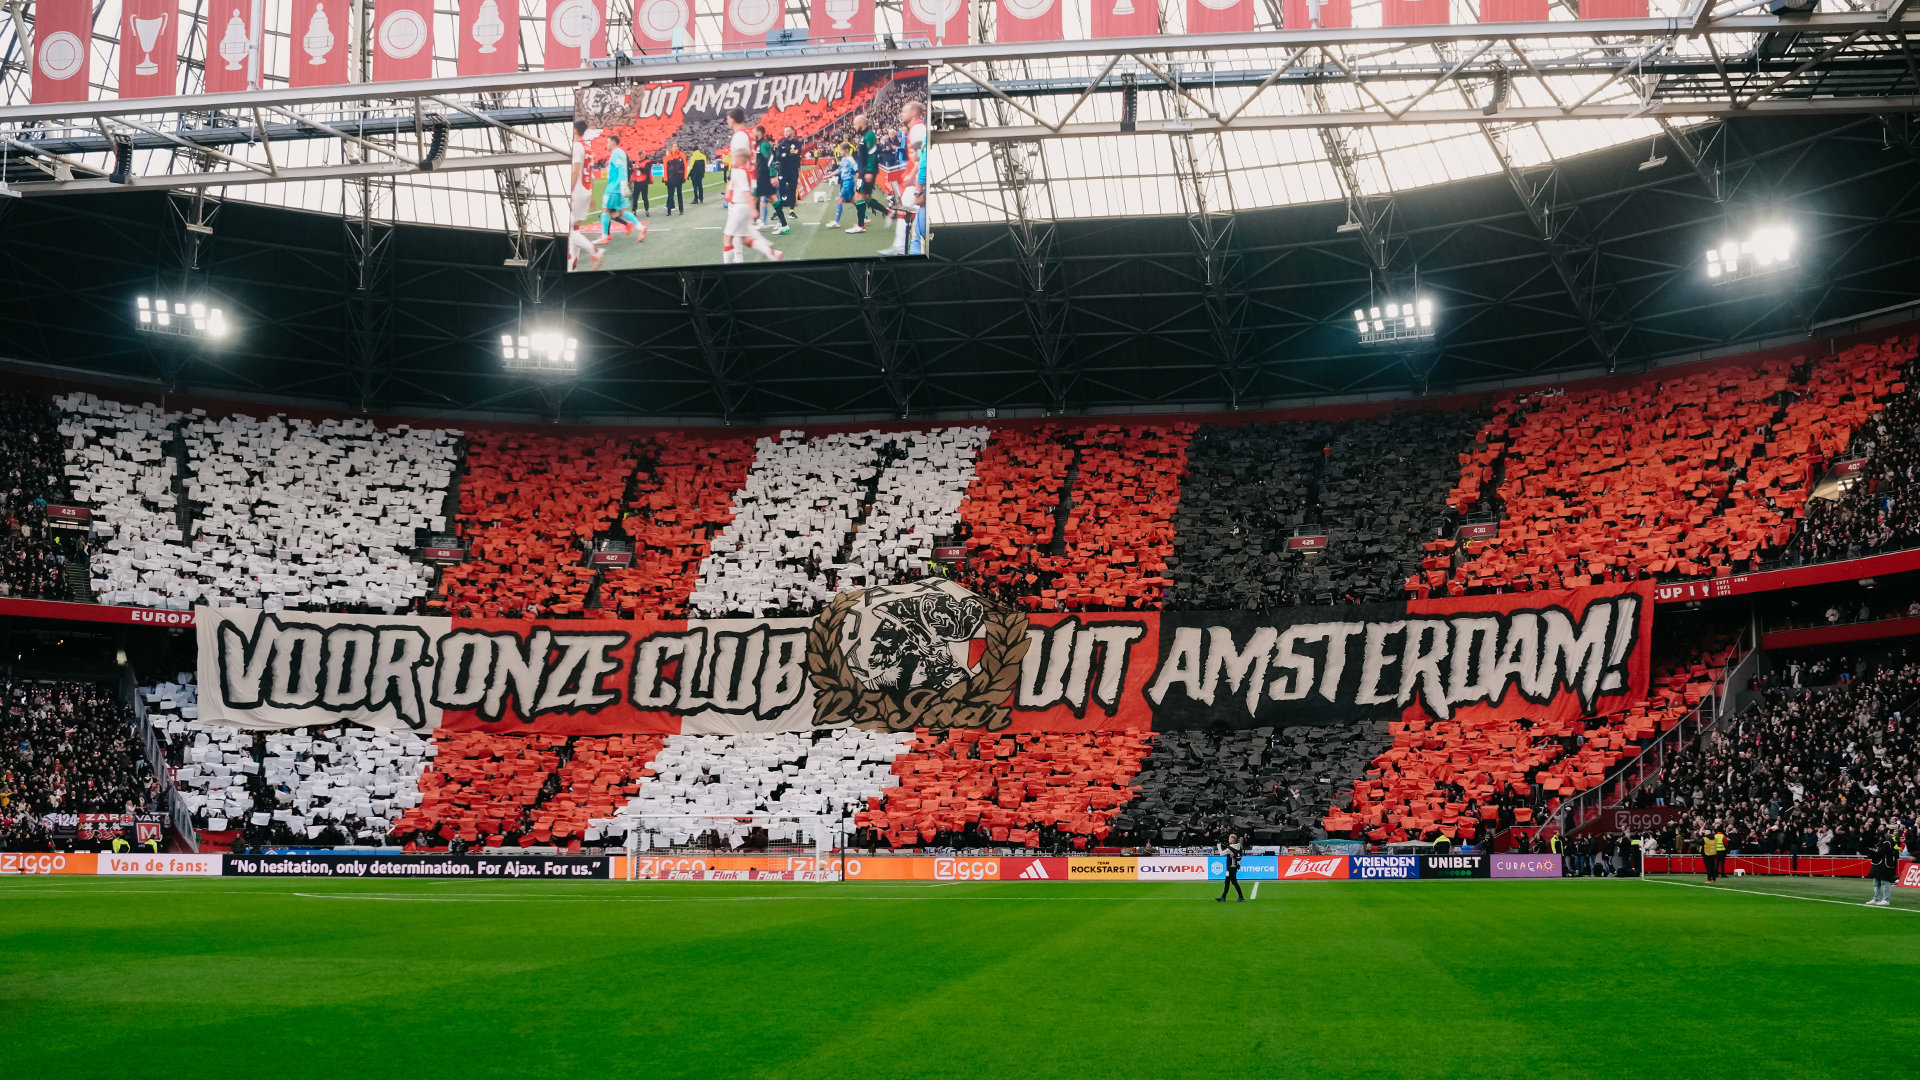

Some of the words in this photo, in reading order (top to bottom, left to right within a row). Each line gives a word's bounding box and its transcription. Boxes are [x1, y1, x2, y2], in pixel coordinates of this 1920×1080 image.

[639, 84, 685, 119] UIT
[683, 71, 848, 117] AMSTERDAM!
[61, 508, 76, 516] 425
[1018, 615, 1147, 719] UIT
[1146, 595, 1638, 722] AMSTERDAM!
[218, 612, 431, 730] VOOR
[431, 625, 632, 723] ONZE
[627, 622, 811, 722] CLUB
[812, 689, 883, 727] 125
[57, 813, 78, 827] 124
[135, 814, 160, 822] VAK
[140, 825, 158, 840] M
[111, 859, 139, 872] Van
[145, 859, 164, 872] de
[169, 859, 208, 873] fans:
[230, 860, 257, 873] “No
[260, 860, 333, 876] hesitation,
[336, 860, 367, 876] only
[369, 860, 474, 875] determination.
[477, 861, 502, 875] For
[504, 861, 541, 878] Ajax.
[544, 862, 568, 876] For
[571, 862, 601, 876] us.”
[1140, 865, 1206, 873] OLYMPIA
[1294, 858, 1333, 873] Bud
[1354, 857, 1415, 867] VRIENDEN
[1428, 857, 1482, 869] UNIBET
[1361, 867, 1408, 878] LOTERIJ
